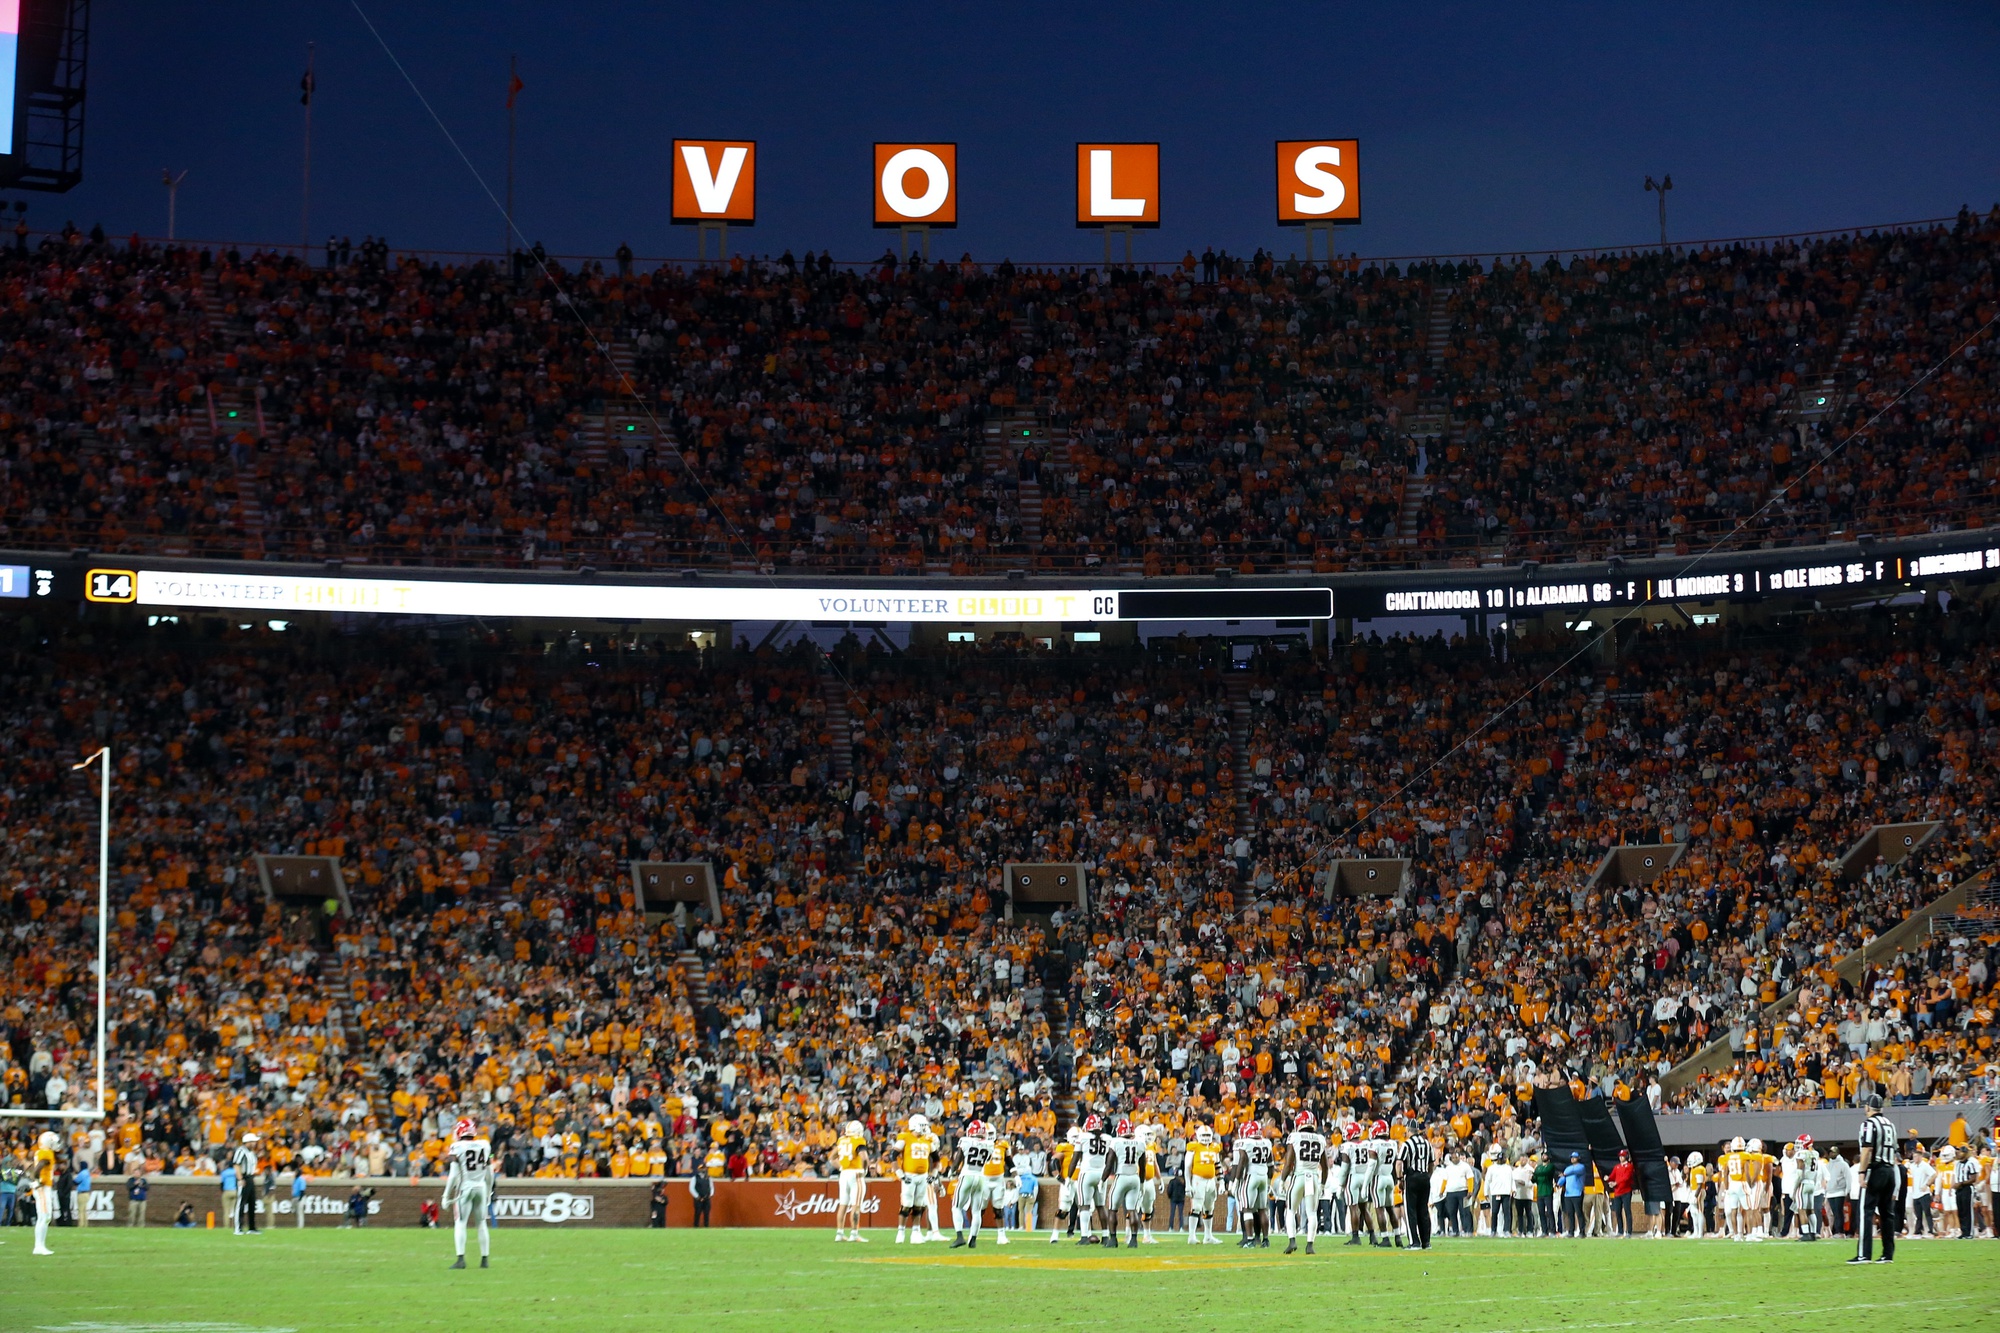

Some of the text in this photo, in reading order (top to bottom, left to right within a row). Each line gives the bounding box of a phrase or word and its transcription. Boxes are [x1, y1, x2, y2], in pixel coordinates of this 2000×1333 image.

[681, 146, 1346, 217] V O L S
[93, 574, 131, 598] 14
[1386, 590, 1480, 611] CHATTANOOGA
[1486, 589, 1503, 607] 10
[1527, 584, 1588, 605] ALABAMA
[1592, 583, 1611, 602] 66
[1627, 582, 1635, 600] F
[1658, 579, 1674, 598] UL
[1676, 575, 1729, 598] MONROE
[1734, 573, 1743, 592] 3
[1769, 573, 1782, 590] 13
[1784, 568, 1806, 588] OLE
[1808, 566, 1842, 587] MISS
[1846, 563, 1864, 583] 35
[1875, 561, 1884, 580] F
[819, 598, 949, 614] VOLUNTEER
[1093, 596, 1114, 615] CC
[967, 1147, 989, 1166] 23
[1089, 1139, 1107, 1155] 96
[1124, 1146, 1136, 1164] 11
[1251, 1147, 1268, 1164] 33
[1300, 1140, 1320, 1162] 22
[1355, 1148, 1368, 1164] 13
[1384, 1148, 1394, 1164] 2
[465, 1149, 490, 1171] 24
[1728, 1160, 1741, 1175] 81
[493, 1192, 573, 1223] WVLT 8
